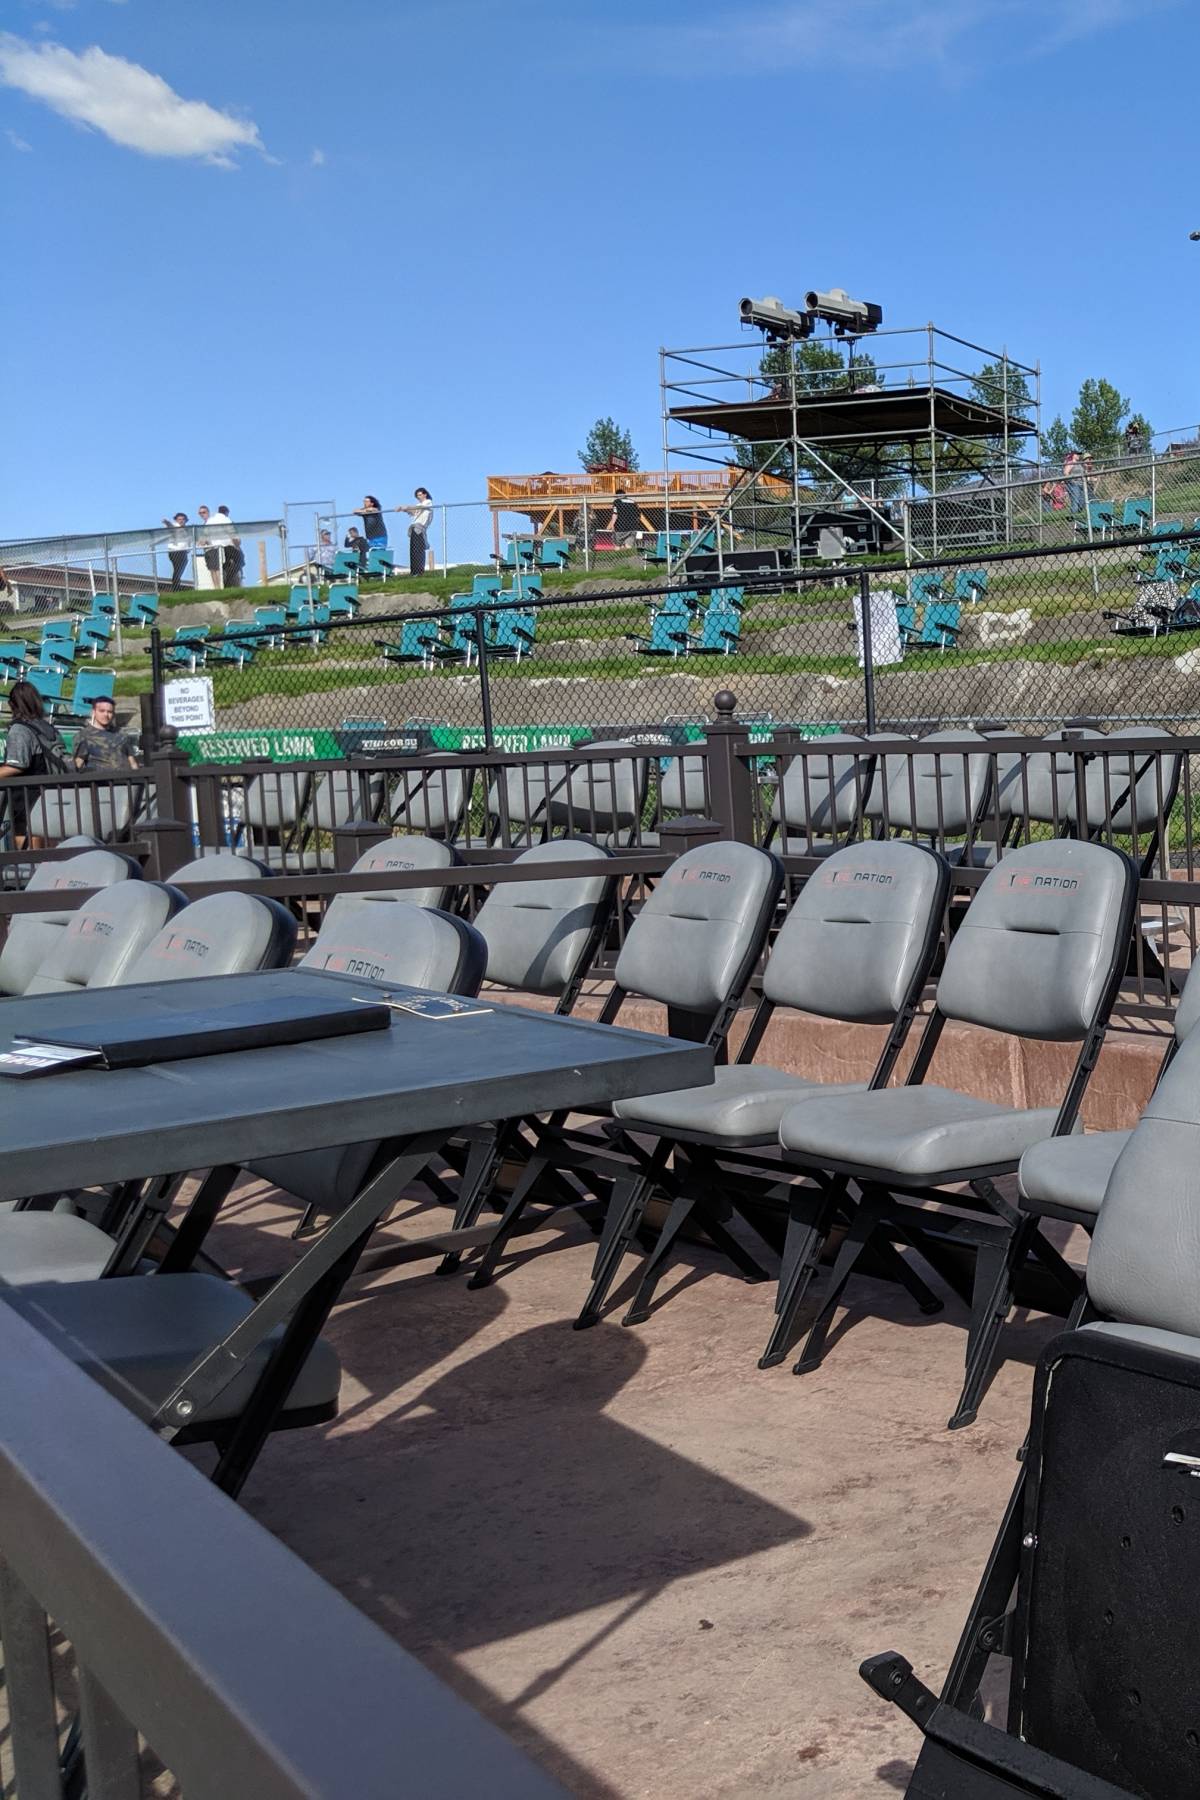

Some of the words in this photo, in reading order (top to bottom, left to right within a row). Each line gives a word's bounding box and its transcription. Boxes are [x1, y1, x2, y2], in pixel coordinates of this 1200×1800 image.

[168, 695, 204, 704] BEVERAGES
[174, 705, 199, 713] BEYOND
[199, 738, 270, 758] RESERVED
[273, 736, 315, 756] LAWN
[699, 871, 732, 883] NATION
[853, 872, 893, 884] NATION
[1034, 876, 1079, 889] NATION
[346, 959, 385, 980] NATION
